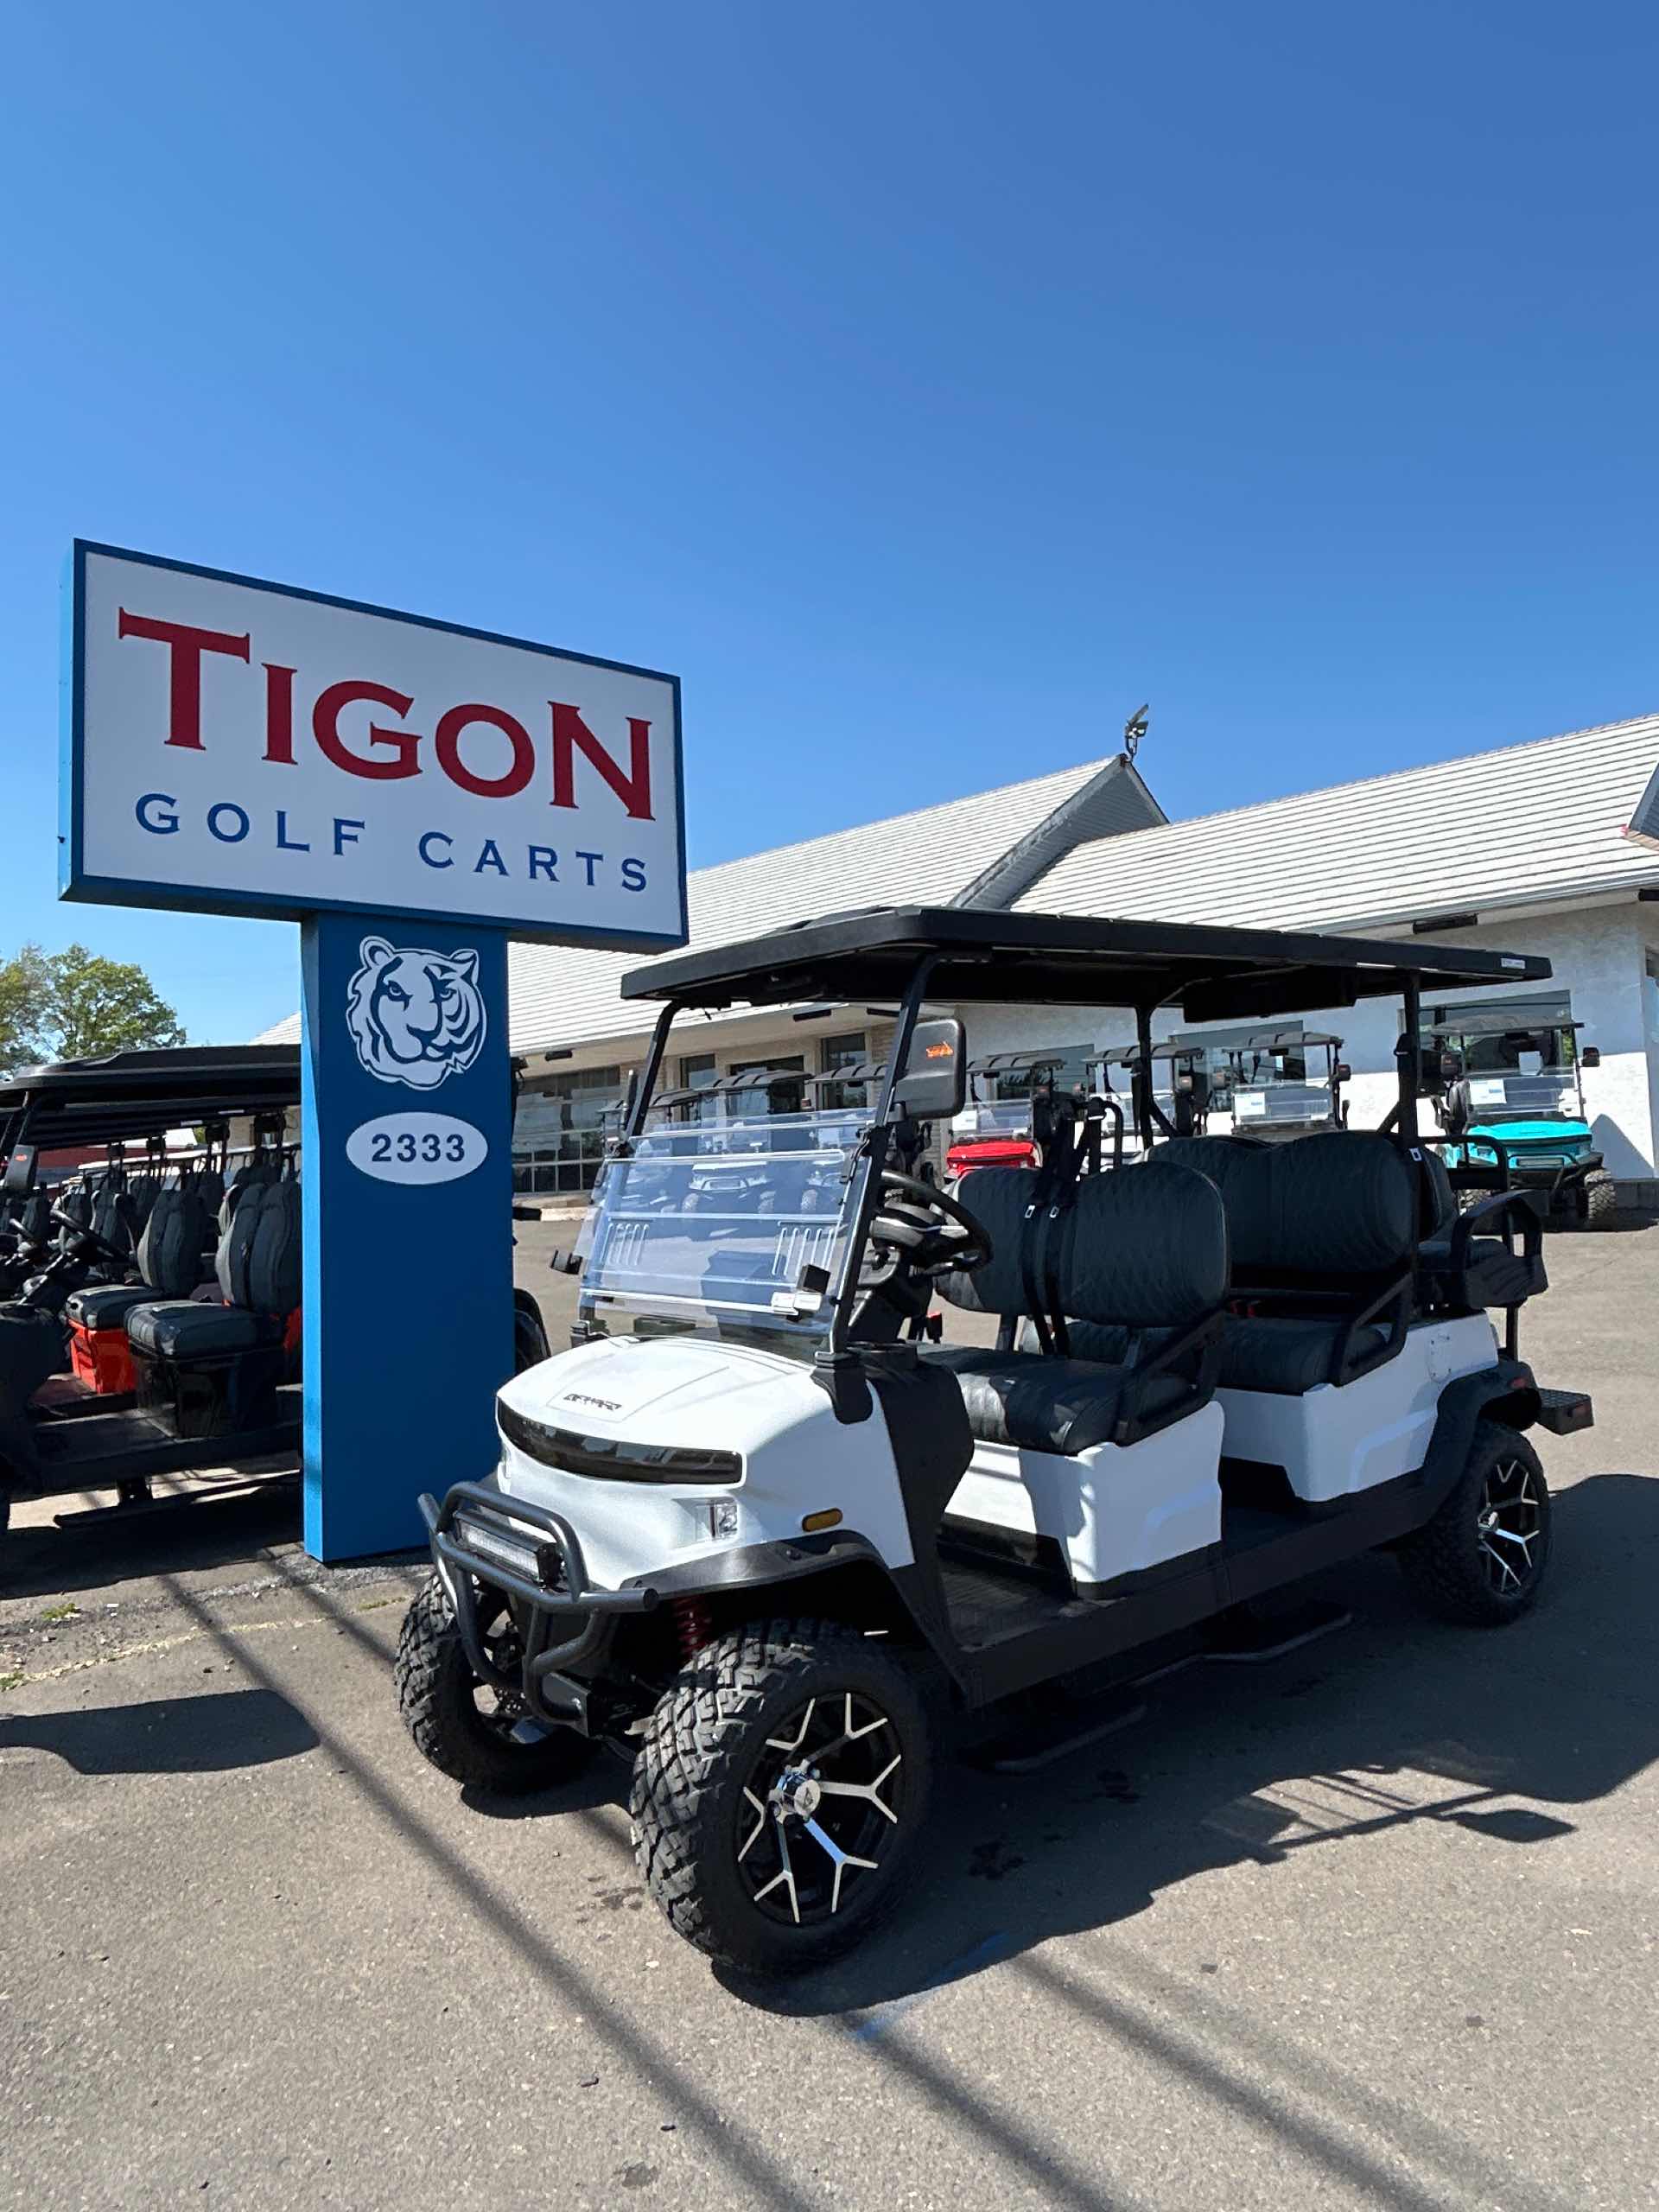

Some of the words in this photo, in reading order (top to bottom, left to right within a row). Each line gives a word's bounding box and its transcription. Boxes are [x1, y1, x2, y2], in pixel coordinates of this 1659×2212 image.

[118, 607, 656, 821] TIGON
[135, 792, 365, 855] GOLF
[418, 831, 647, 893] CARTS
[372, 1133, 465, 1162] 2333
